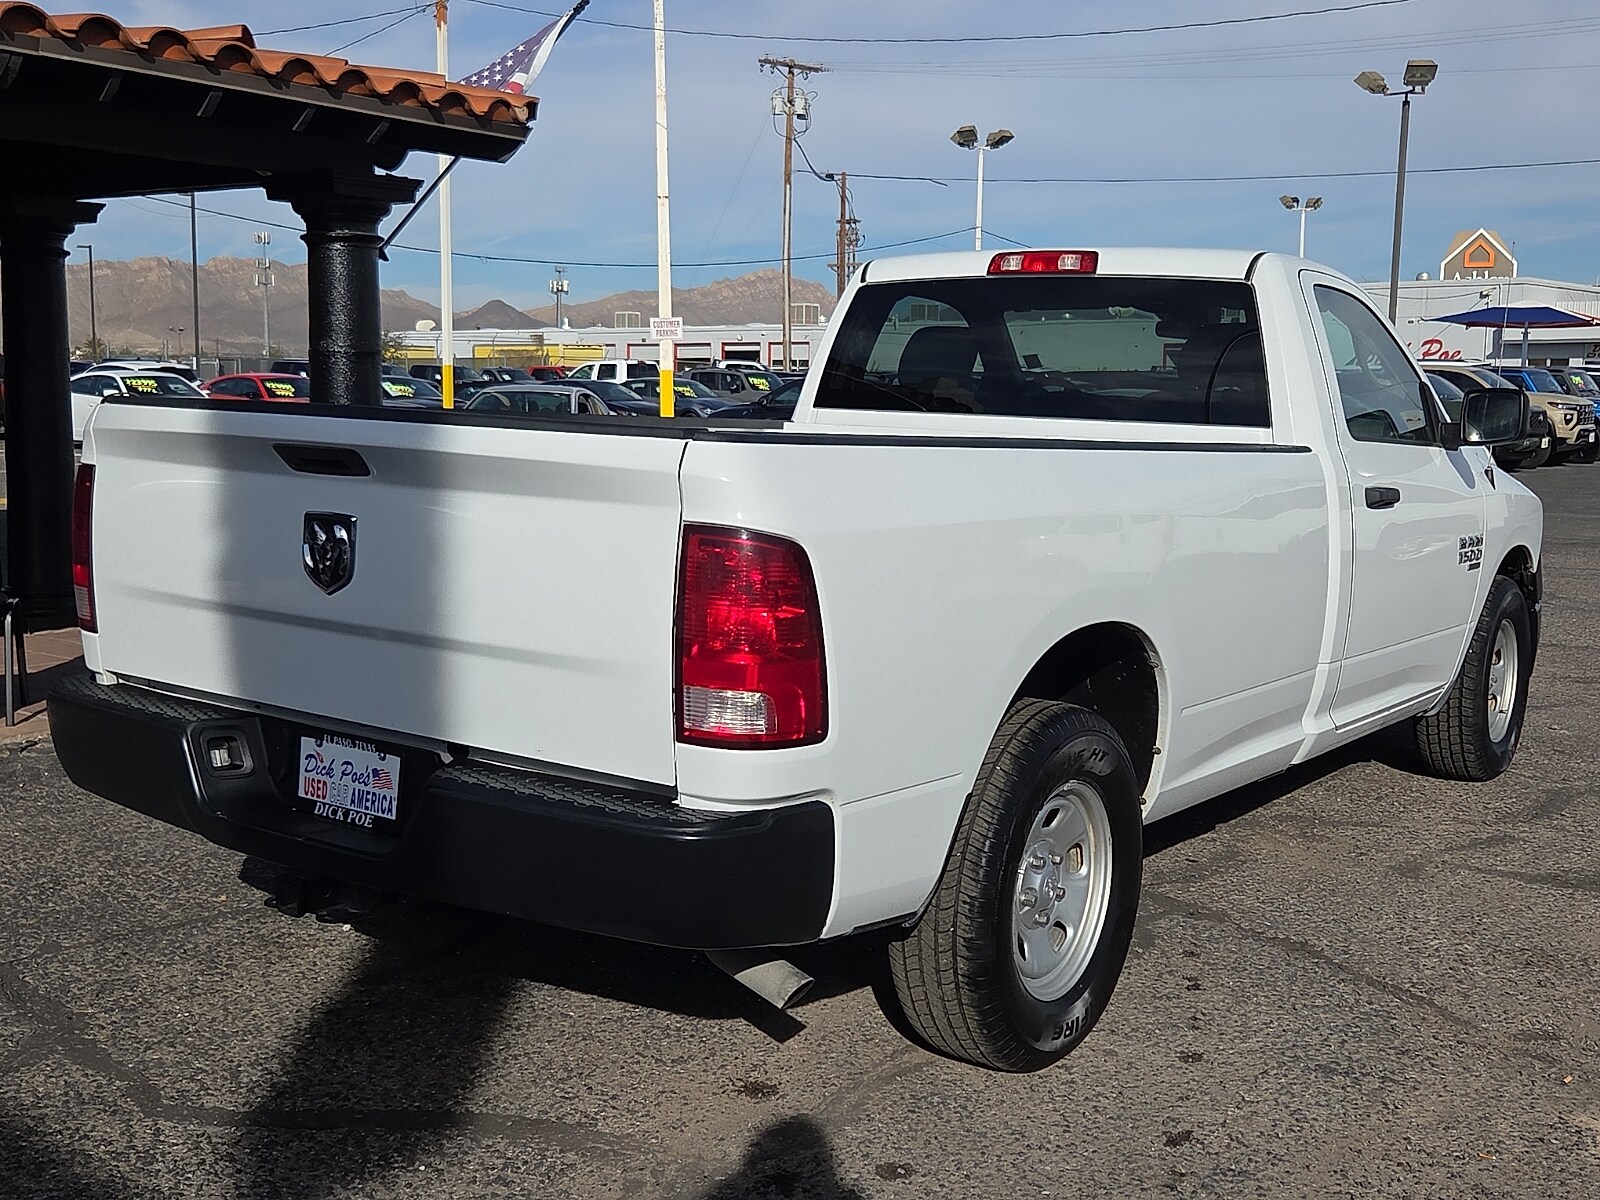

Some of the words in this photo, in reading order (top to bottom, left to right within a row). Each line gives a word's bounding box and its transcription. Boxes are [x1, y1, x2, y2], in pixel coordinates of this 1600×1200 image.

[652, 320, 681, 329] CUSTOMER
[655, 329, 679, 338] PARKING
[1421, 339, 1463, 360] Poe
[1458, 549, 1483, 565] 1500
[323, 734, 335, 745] EL
[355, 741, 376, 753] TEXAS
[1089, 747, 1110, 763] HT
[304, 753, 335, 779] Dick
[340, 760, 371, 787] Poe's
[303, 776, 328, 800] USED
[349, 787, 395, 817] AMERICA
[314, 802, 346, 821] DICK
[346, 810, 375, 828] POE
